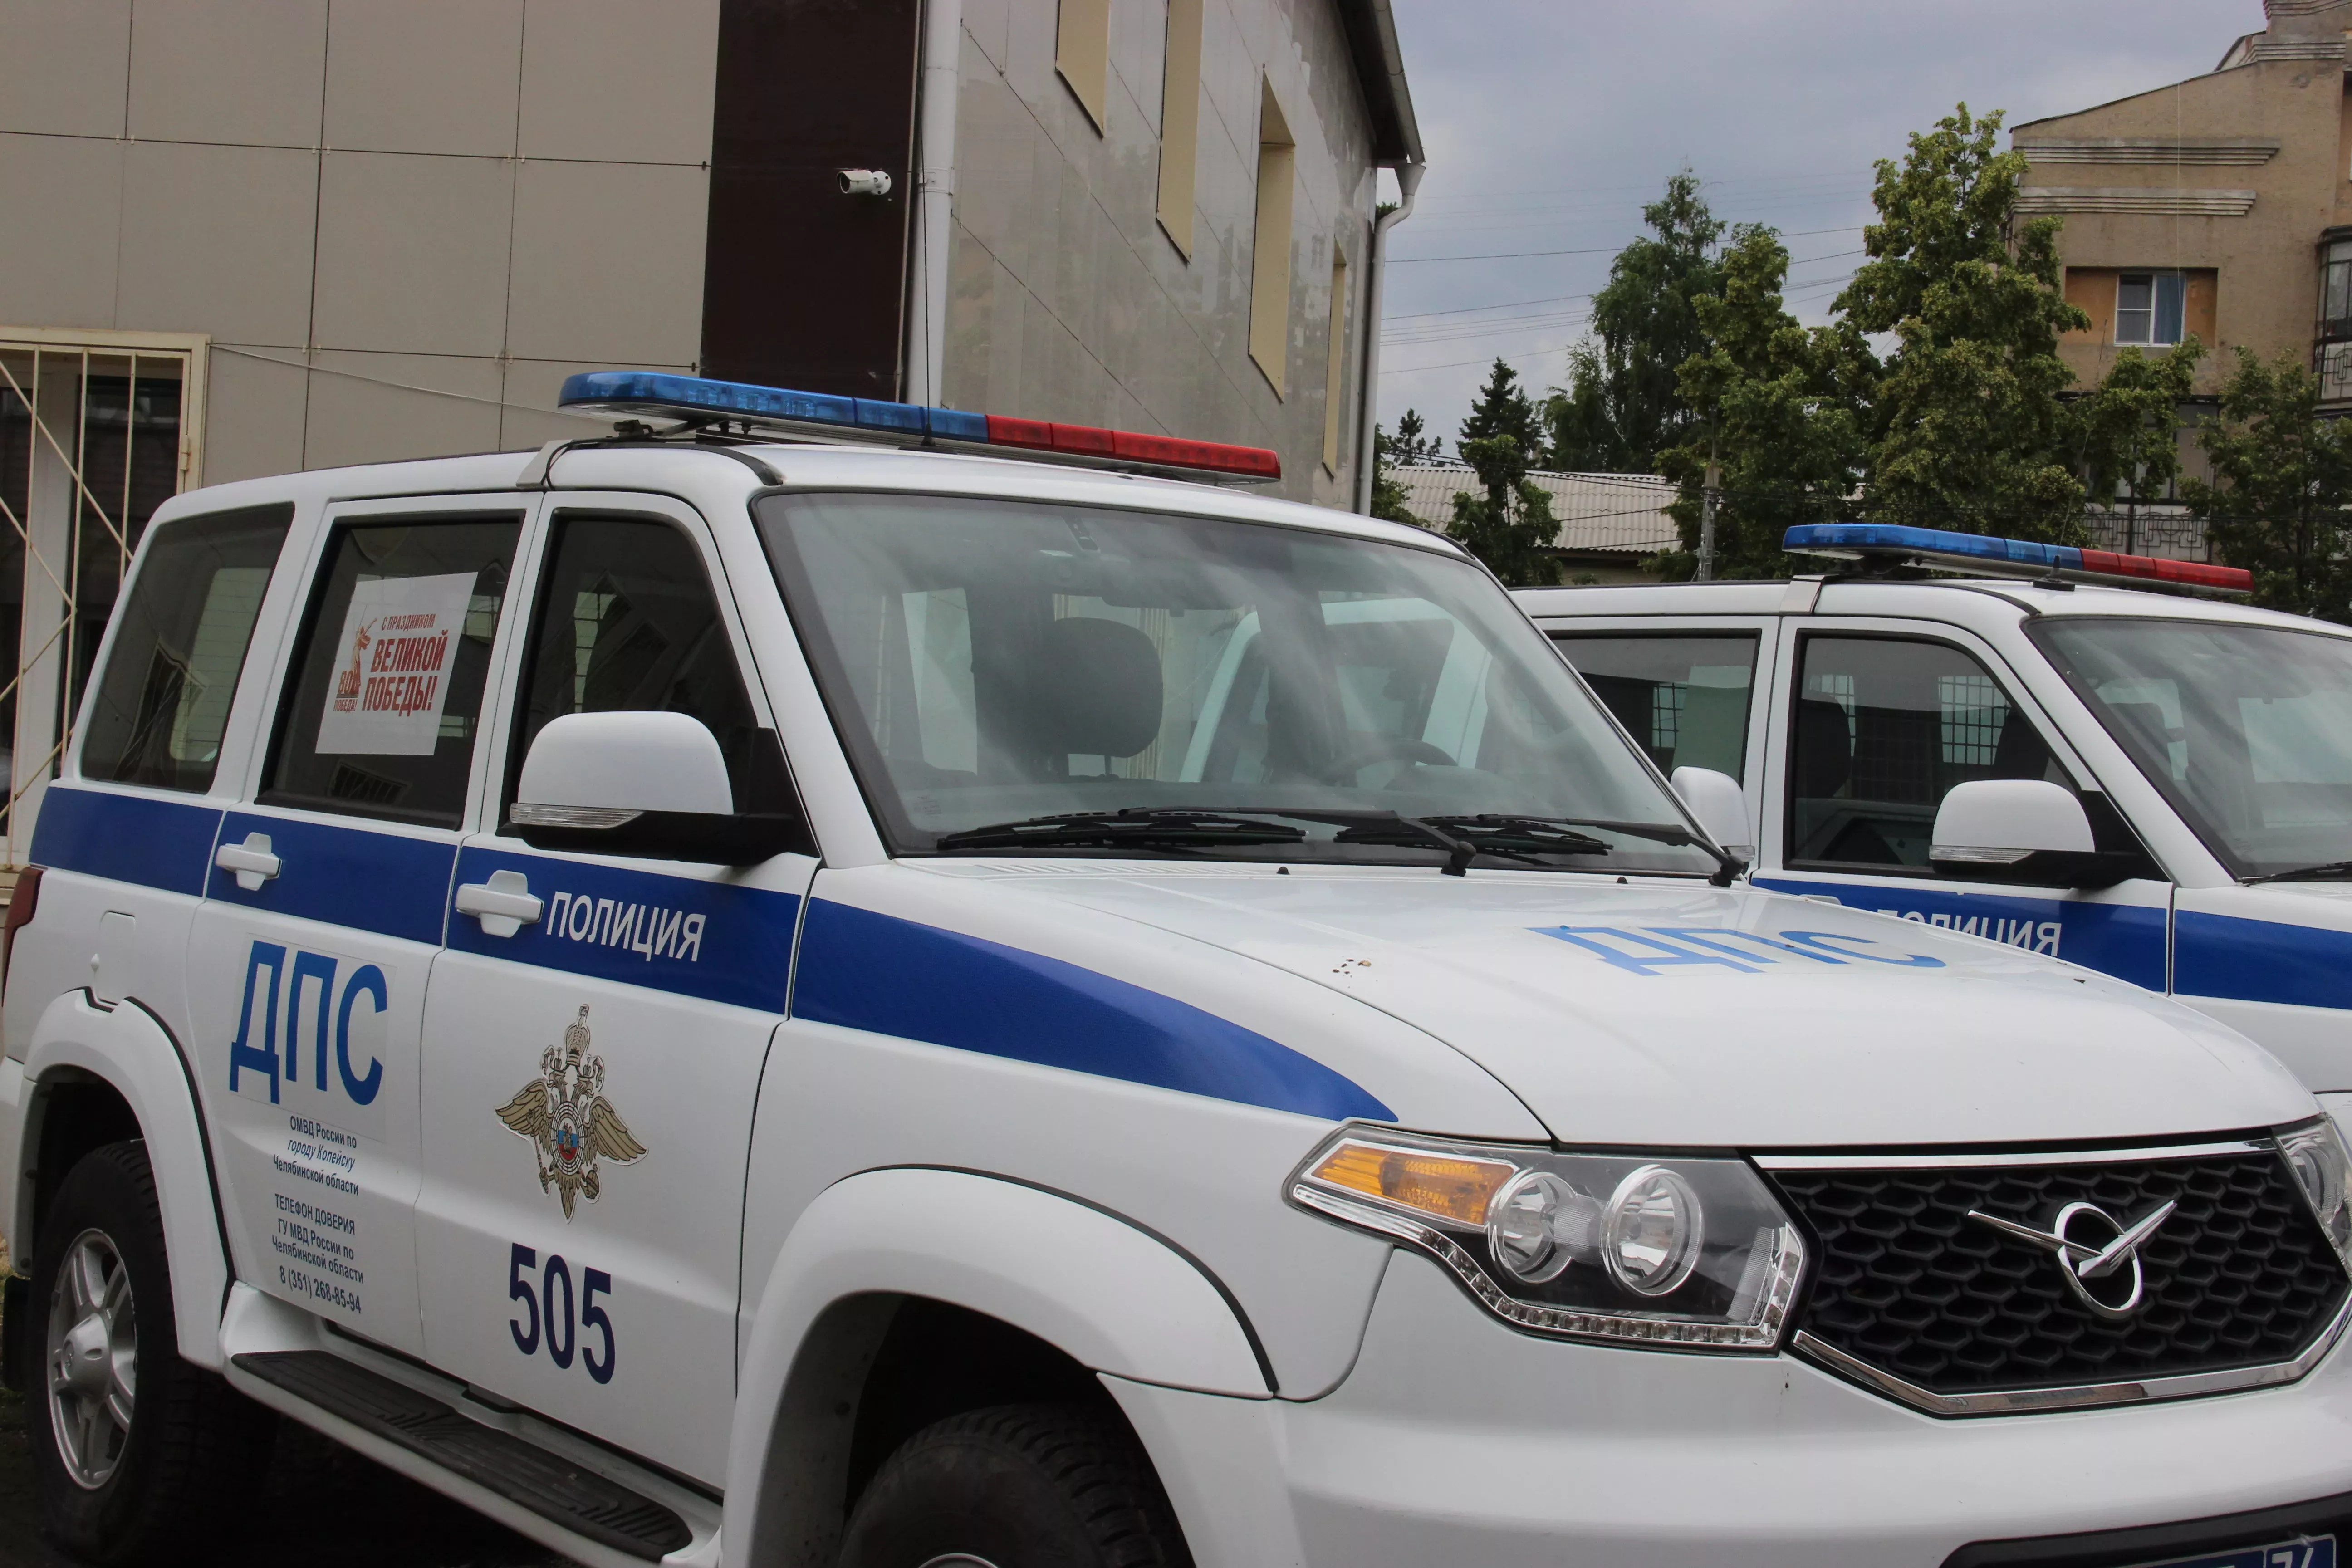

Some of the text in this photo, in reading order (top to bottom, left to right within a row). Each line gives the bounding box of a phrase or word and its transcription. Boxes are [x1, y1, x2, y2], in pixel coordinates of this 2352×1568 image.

[382, 613, 436, 632] С ПРАЗДНИКОМ
[370, 629, 449, 672] ВЕЛИКОЙ
[333, 699, 358, 713] ПОБЕДА!
[362, 676, 438, 717] ПОБЕДЫ!
[547, 891, 706, 962] ПОЛИЦИЯ
[1877, 909, 2062, 956] ИЦИЯ
[1523, 926, 1947, 976] ДПС
[229, 940, 388, 1105] ДПС
[290, 1115, 357, 1149] ОМВД России по
[274, 1154, 359, 1196] Челябинской области
[287, 1139, 356, 1173] городу Копейску
[274, 1193, 355, 1235] ТЕЛЕФОН ДОВЕРИЯ
[272, 1235, 363, 1284] Челябинской области
[278, 1218, 354, 1260] ГУ МВД России по
[280, 1265, 361, 1314] 8 (351) 268-85-94
[509, 1241, 616, 1385] 505
